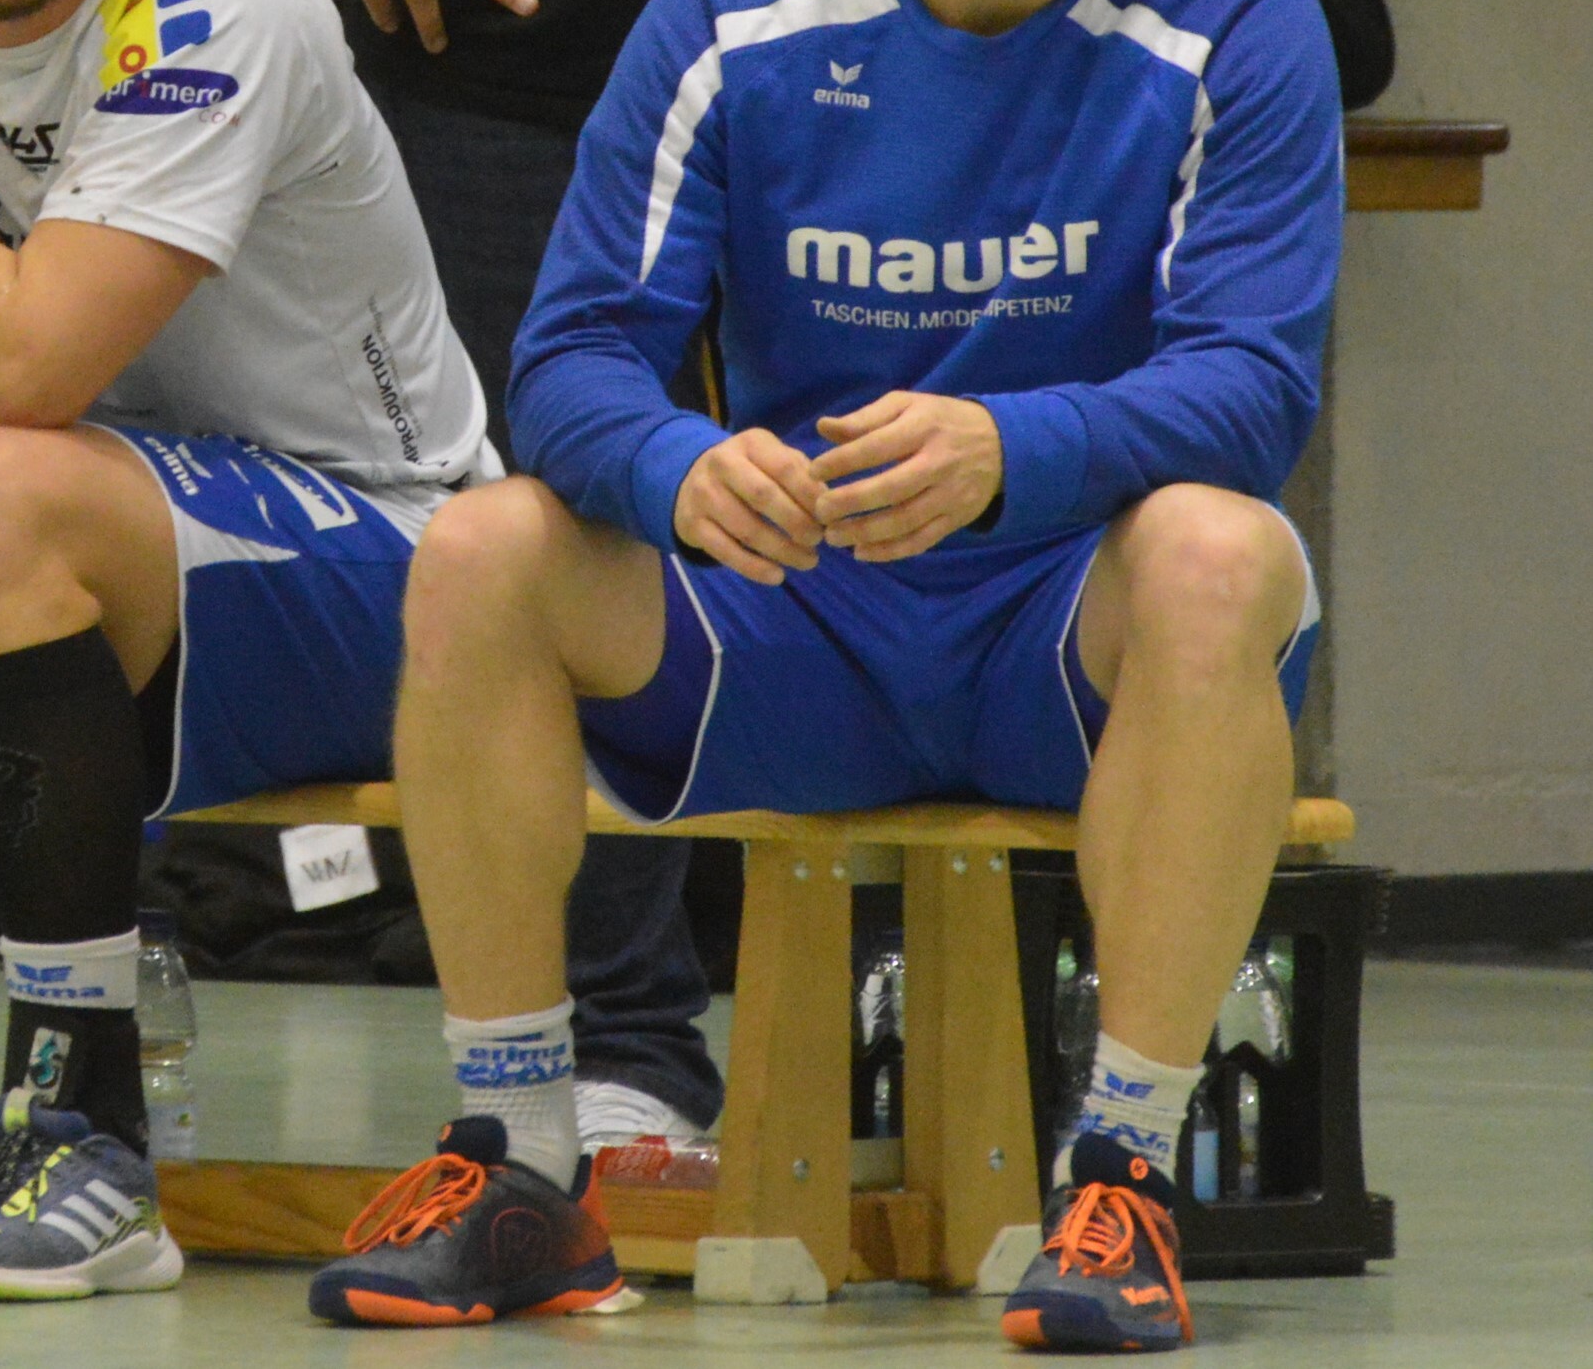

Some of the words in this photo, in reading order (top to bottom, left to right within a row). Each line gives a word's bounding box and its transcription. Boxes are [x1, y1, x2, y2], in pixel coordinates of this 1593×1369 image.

[813, 87, 871, 110] erima
[786, 220, 1100, 294] mauer
[143, 436, 200, 497] erima
